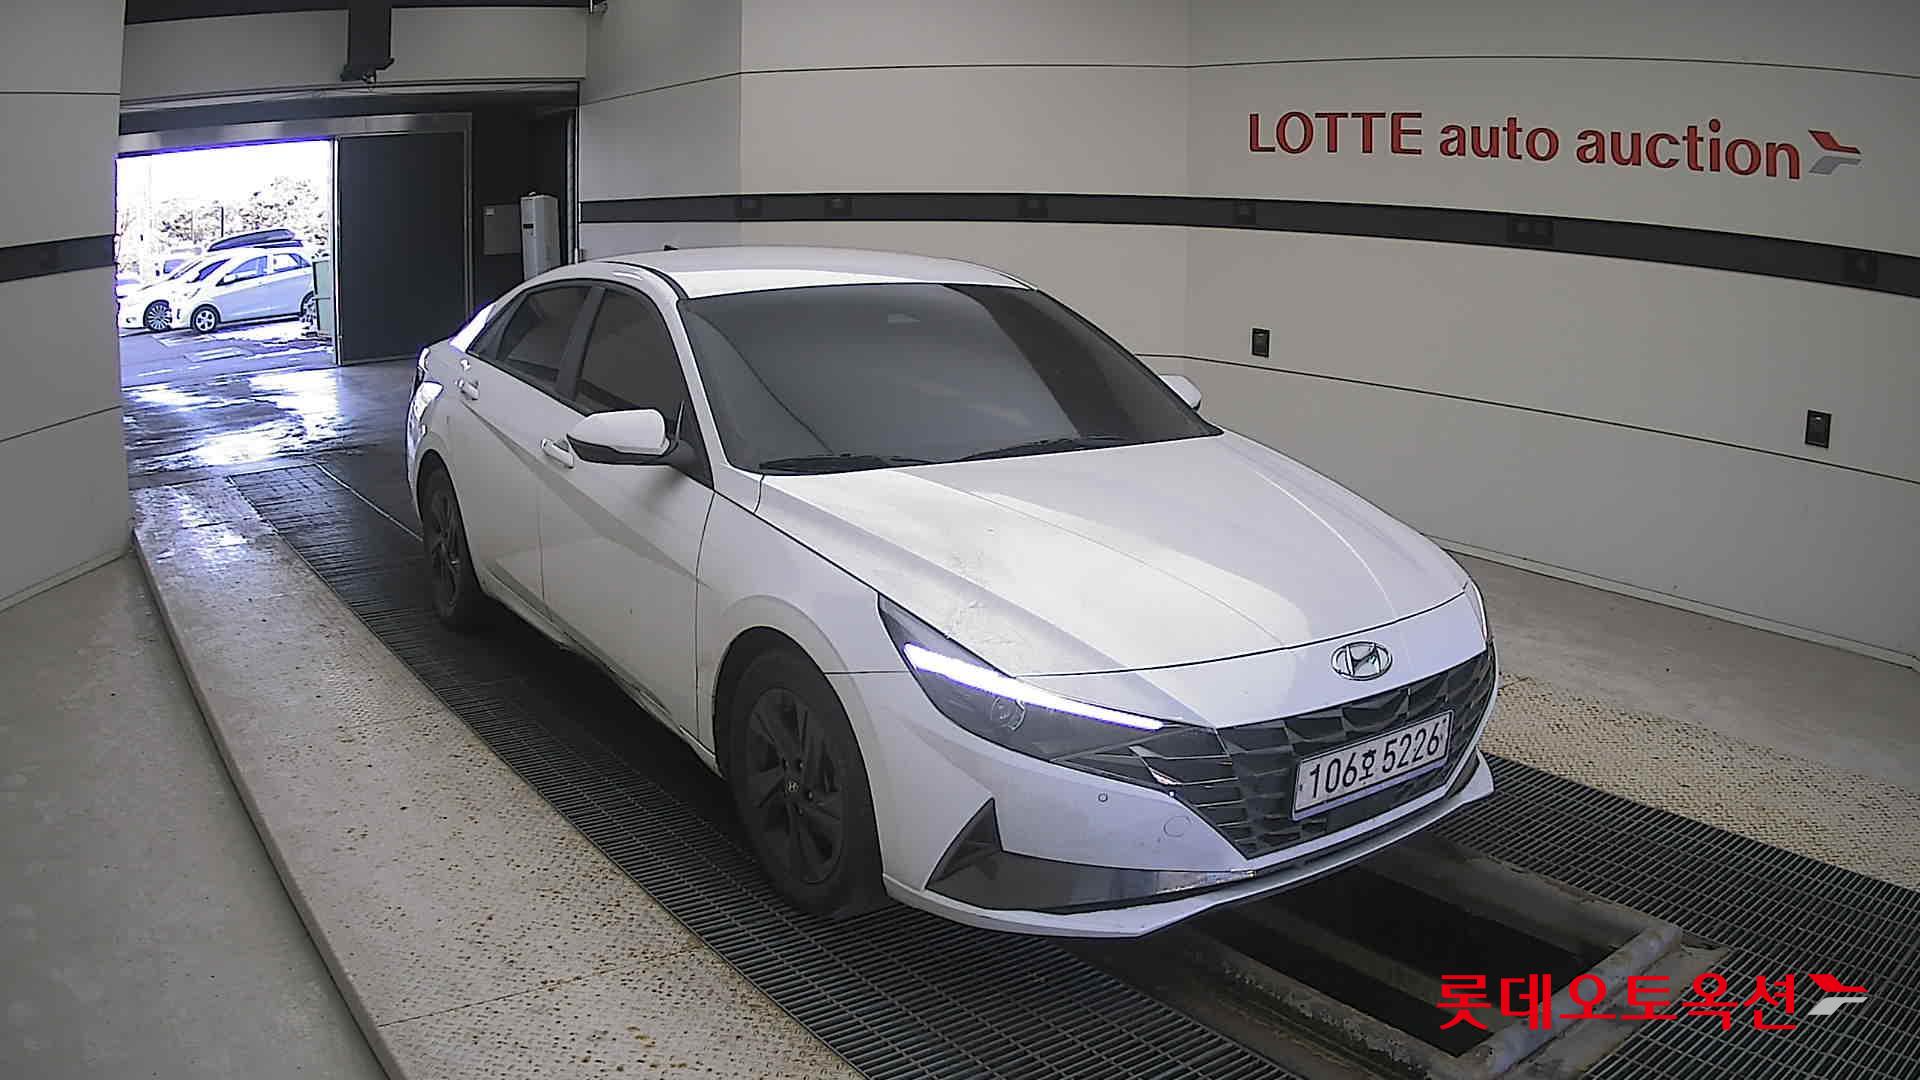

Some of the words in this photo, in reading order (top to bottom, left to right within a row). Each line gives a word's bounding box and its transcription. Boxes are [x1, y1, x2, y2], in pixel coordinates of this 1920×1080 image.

[1248, 112, 1423, 155] LOTTE
[1439, 116, 1560, 162] auto
[1575, 118, 1801, 180] auction
[1309, 749, 1377, 799] 106호
[1382, 721, 1440, 773] 5226
